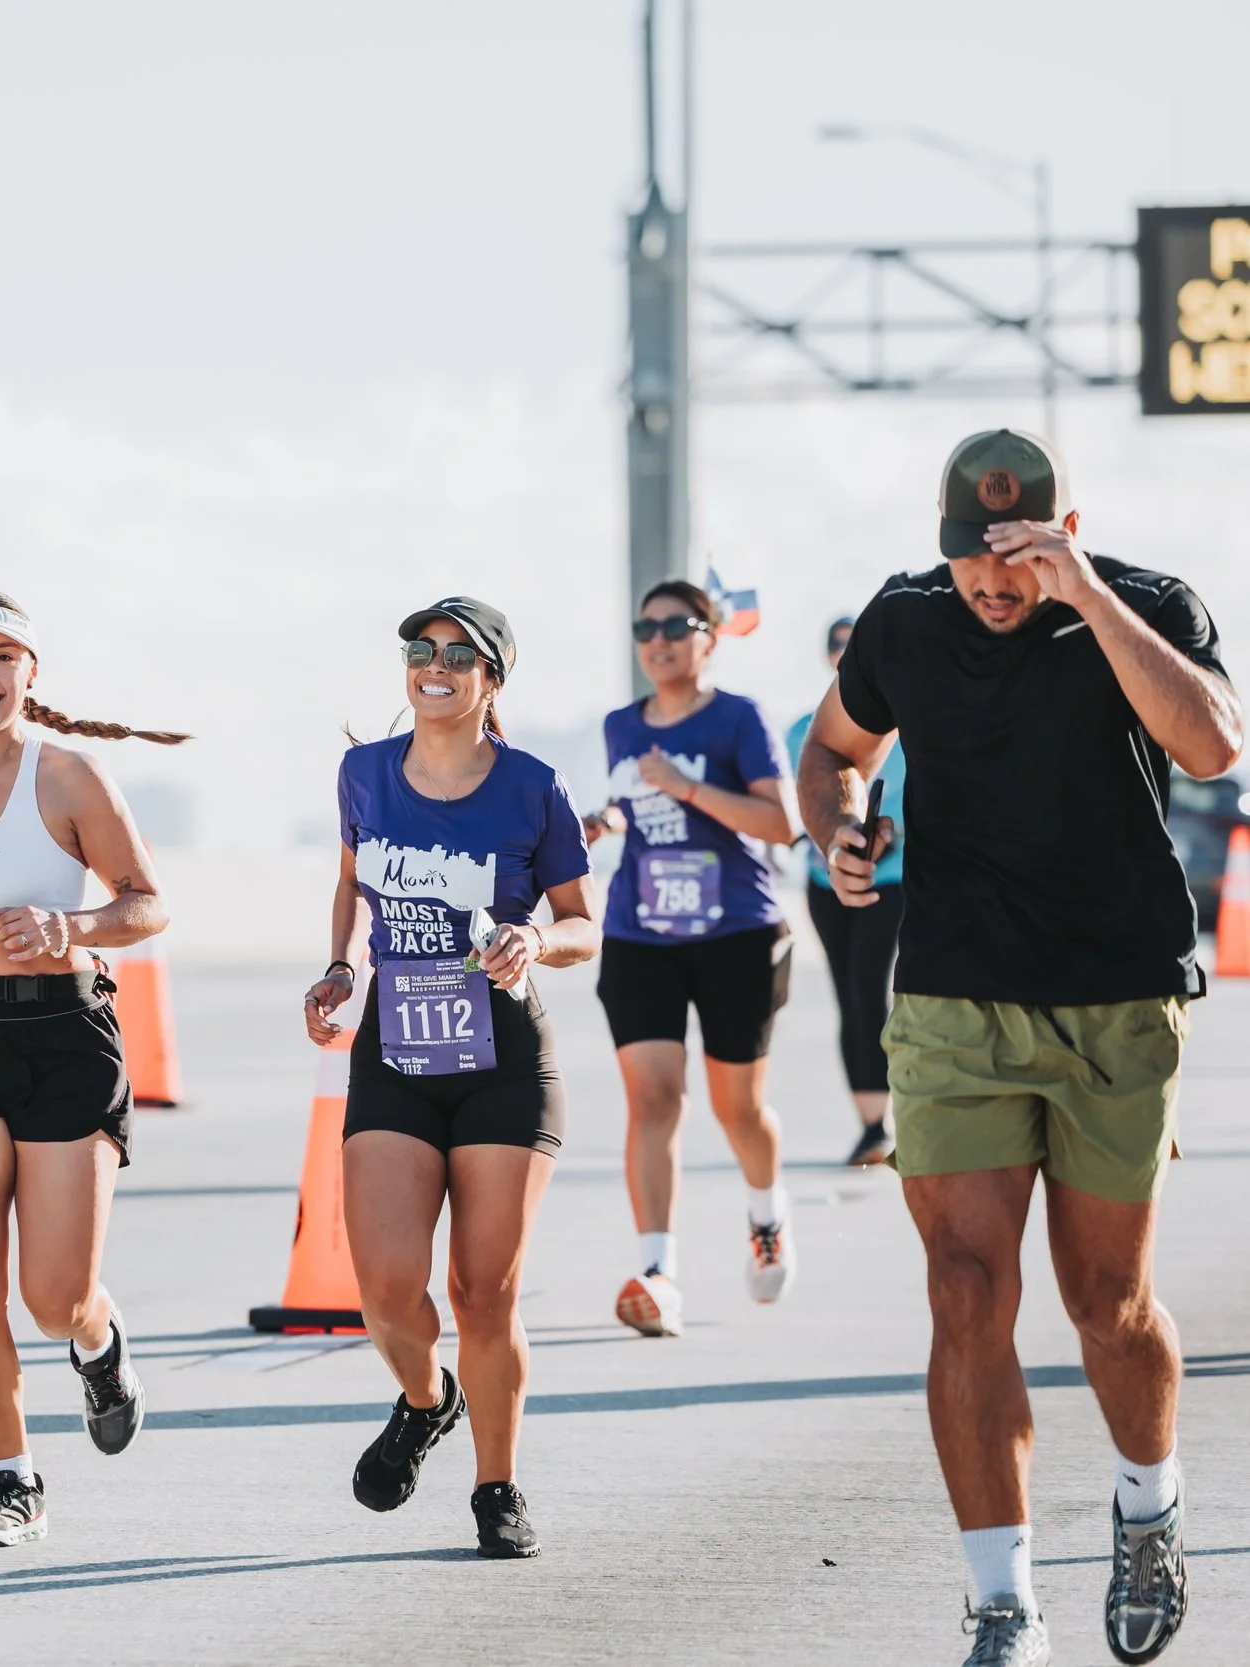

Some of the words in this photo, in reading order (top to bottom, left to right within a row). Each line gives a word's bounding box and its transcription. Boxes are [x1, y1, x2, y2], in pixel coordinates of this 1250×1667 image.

[382, 856, 448, 892] Miami's
[653, 879, 702, 913] 758
[379, 898, 447, 921] MOST
[390, 928, 457, 954] RACE
[396, 999, 474, 1040] 1112
[397, 1056, 411, 1064] Gear
[459, 1053, 474, 1061] Free
[403, 1064, 423, 1075] 1112
